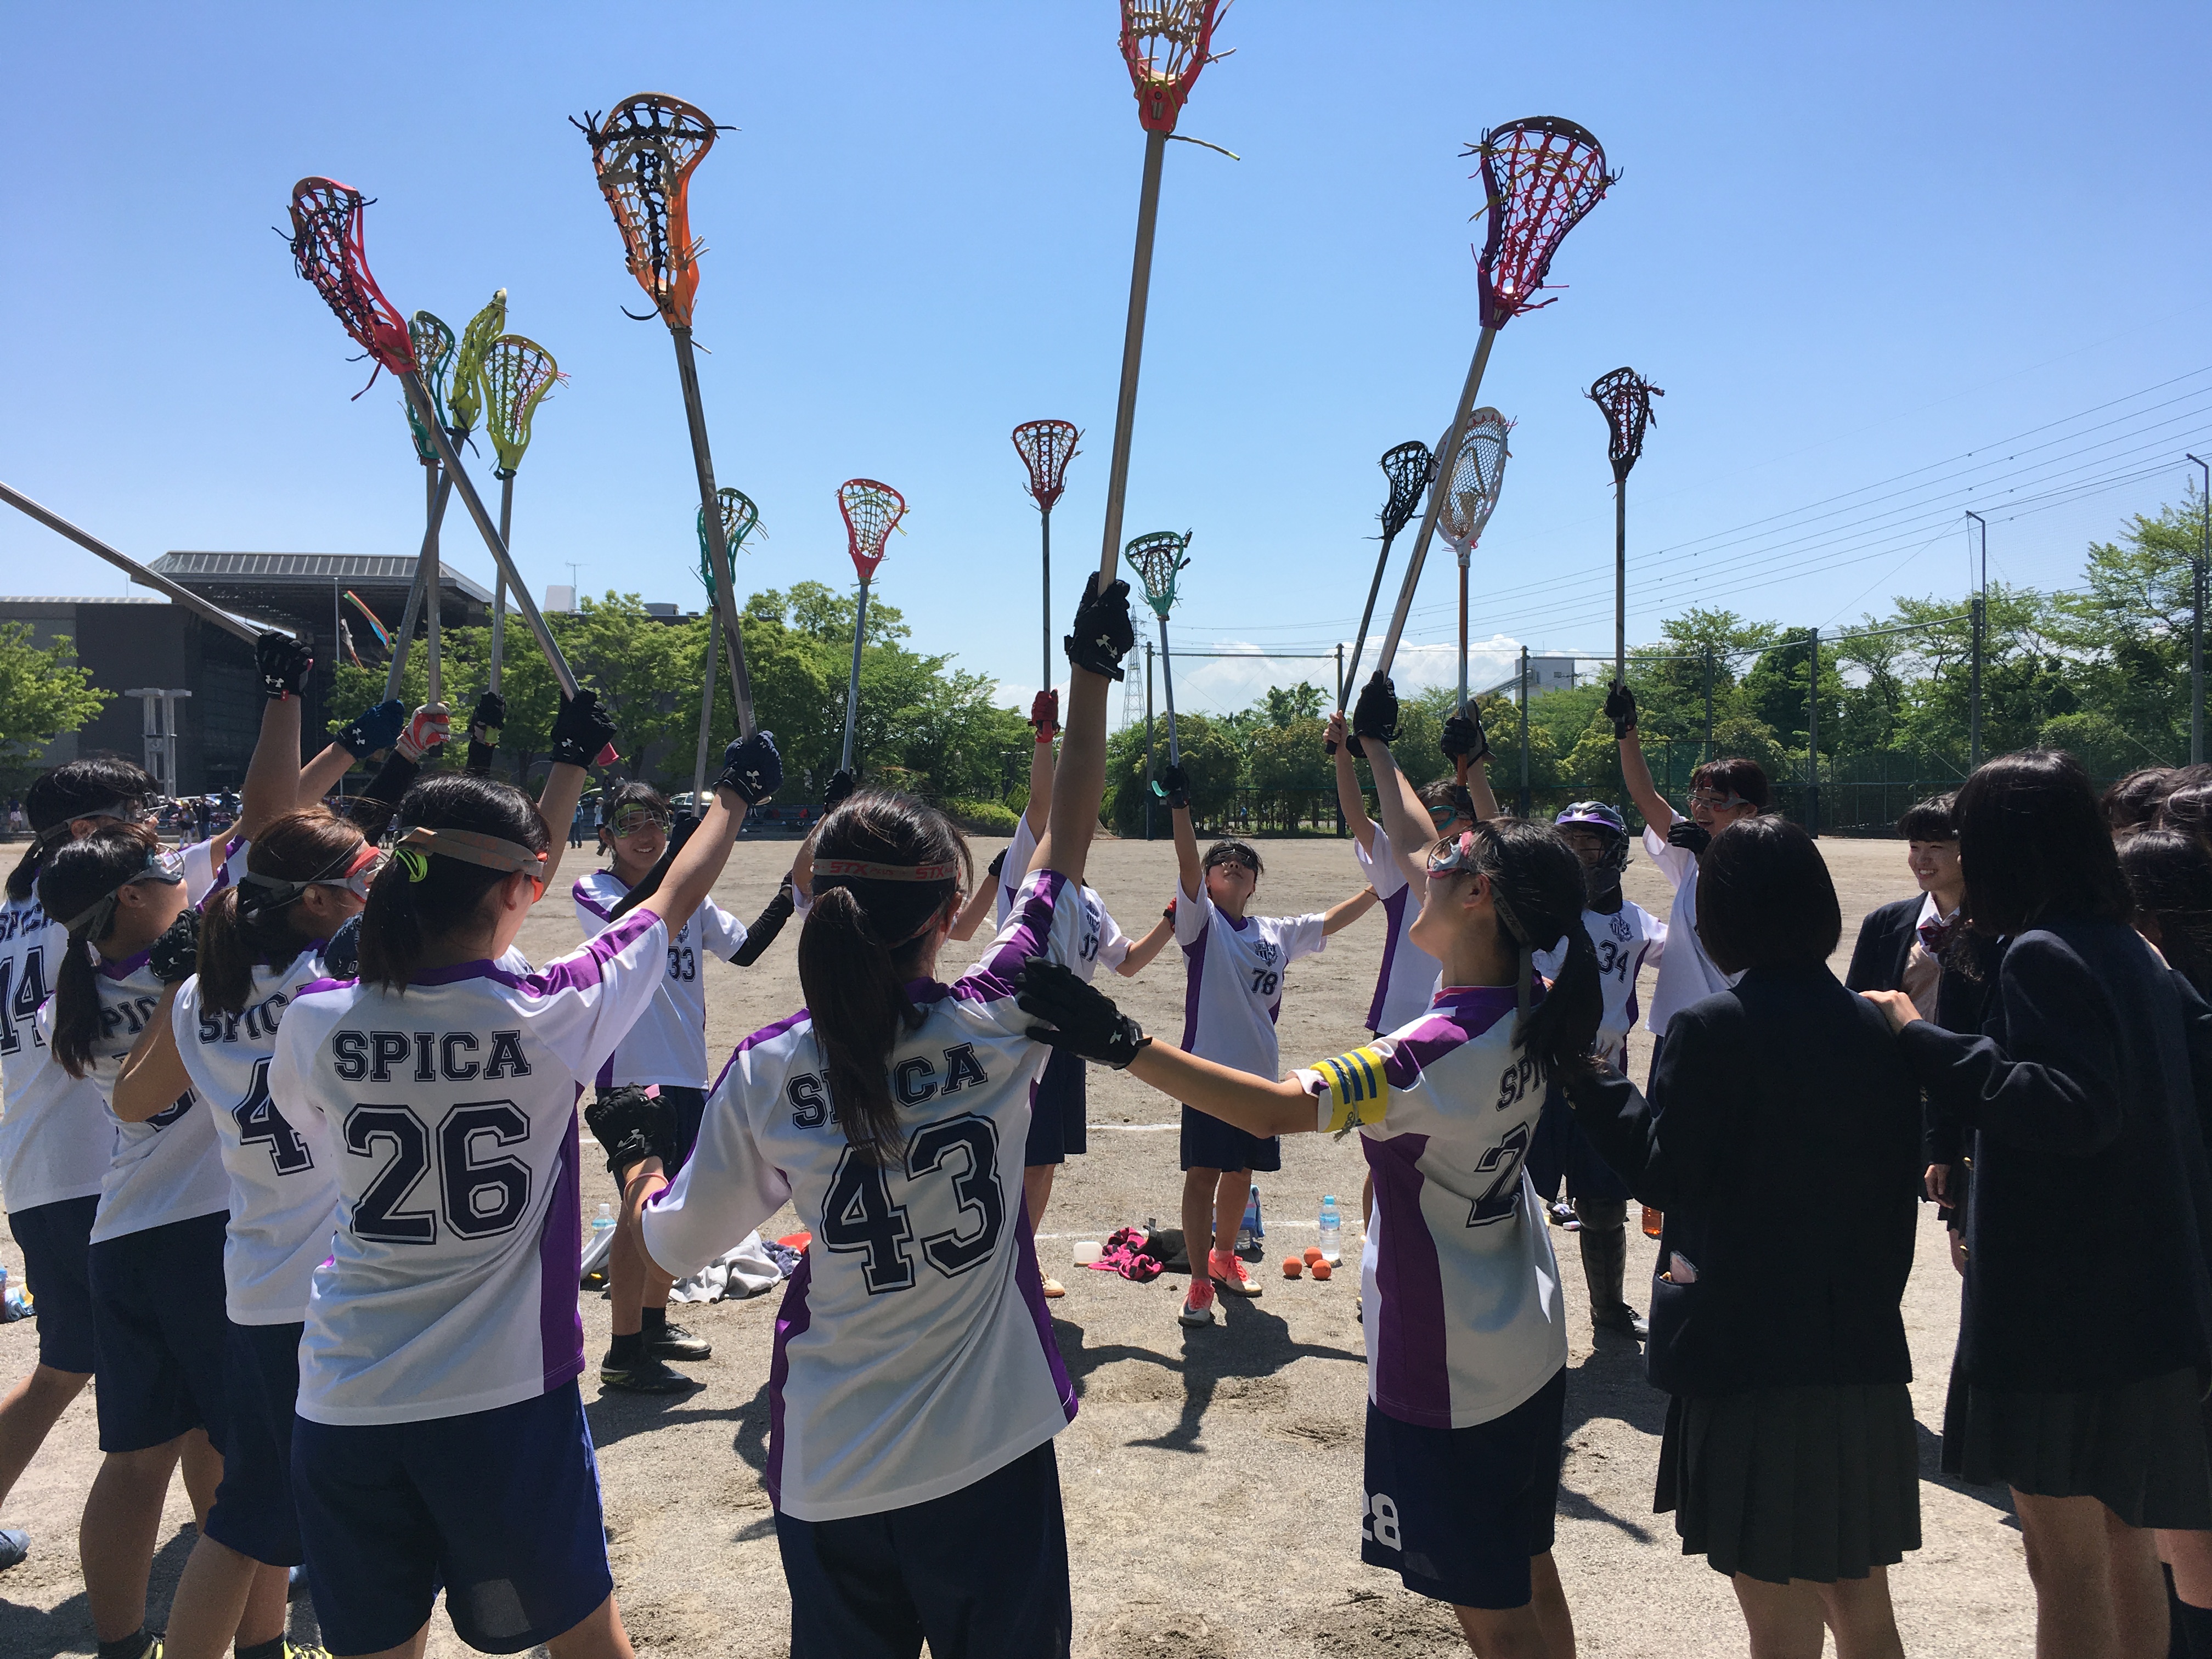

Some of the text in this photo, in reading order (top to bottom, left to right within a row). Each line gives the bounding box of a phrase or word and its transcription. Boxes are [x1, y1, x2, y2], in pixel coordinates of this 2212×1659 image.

[830, 861, 869, 876] STX
[915, 865, 945, 879] STX
[667, 946, 696, 983] 33
[1079, 932, 1099, 963] 17
[1599, 939, 1630, 984] 34
[0, 945, 57, 1056] 14
[1251, 967, 1279, 996] 78
[198, 982, 313, 1045] SPIC
[332, 1029, 532, 1082] SPICA
[343, 1099, 532, 1245] 26
[819, 1111, 1006, 1296] 43
